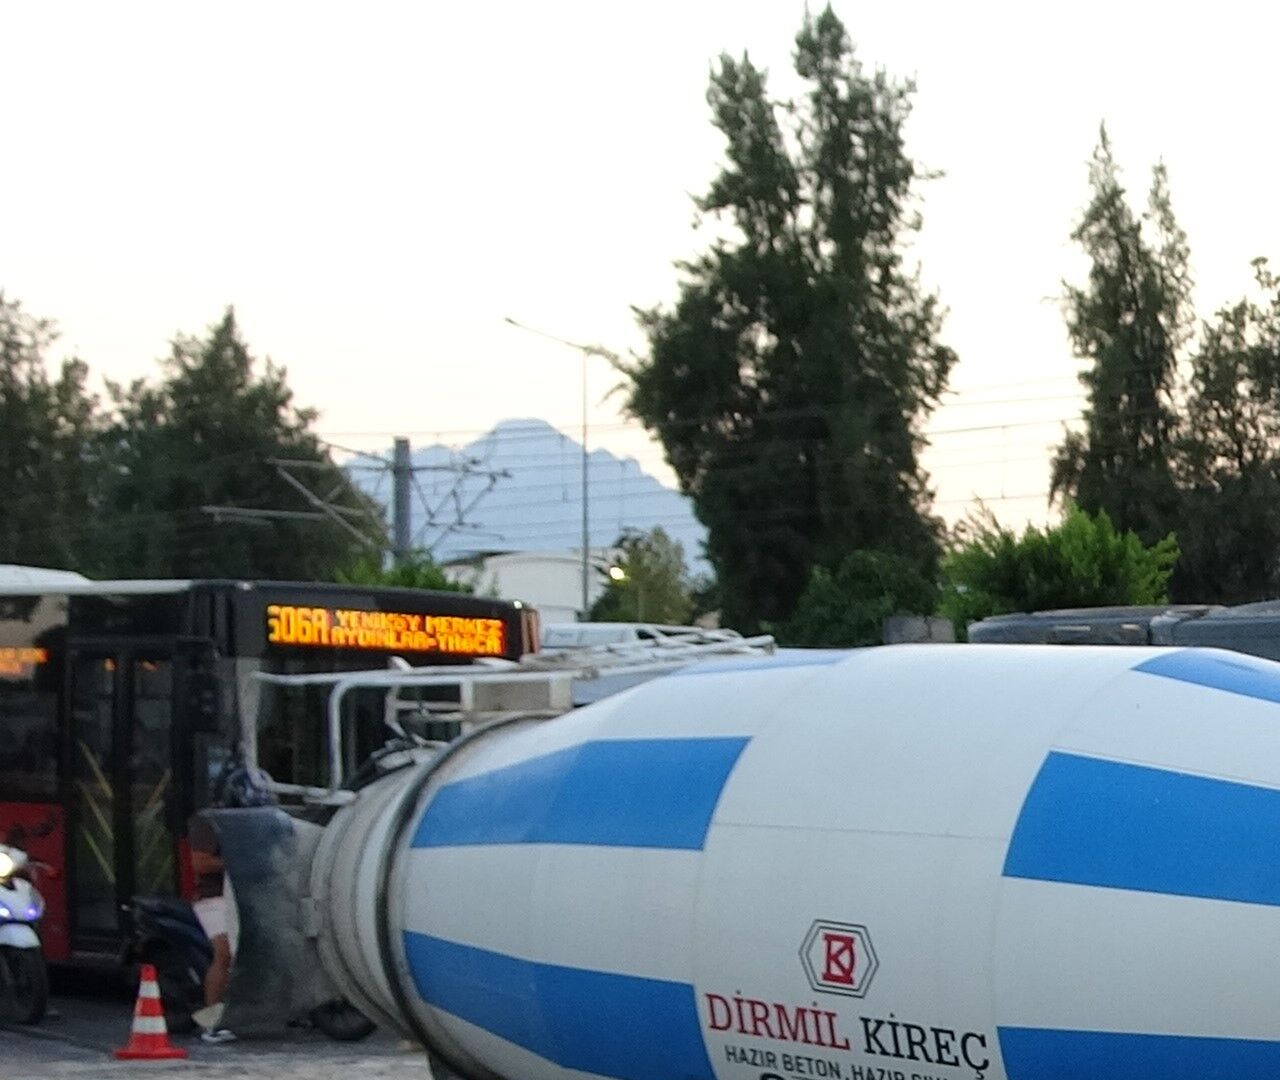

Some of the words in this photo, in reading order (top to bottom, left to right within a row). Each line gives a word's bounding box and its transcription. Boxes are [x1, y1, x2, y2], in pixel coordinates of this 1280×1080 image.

[705, 989, 850, 1050] DİRMİL
[859, 1013, 989, 1080] KİREÇ
[724, 1045, 778, 1069] HAZIR
